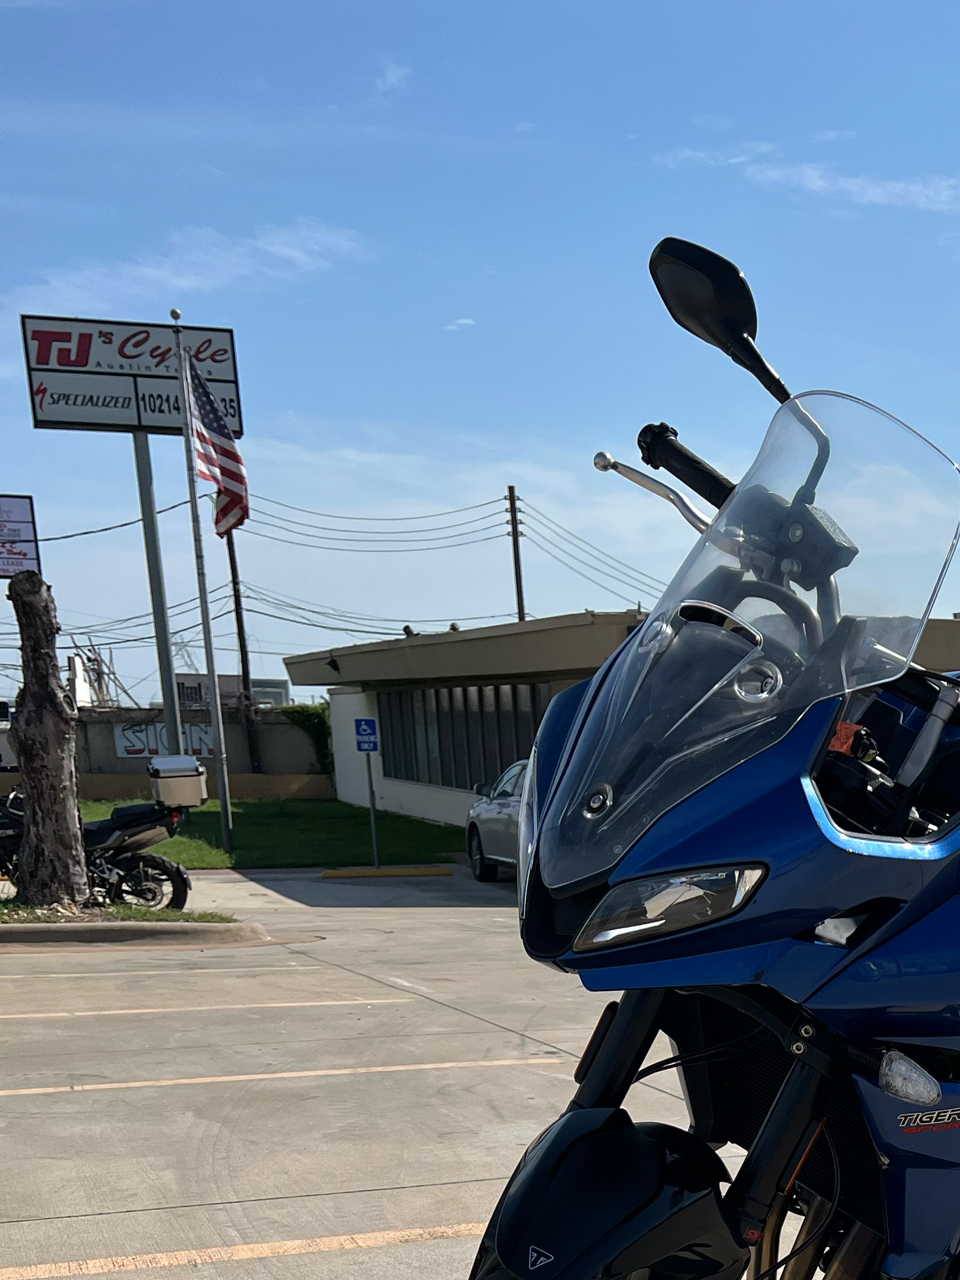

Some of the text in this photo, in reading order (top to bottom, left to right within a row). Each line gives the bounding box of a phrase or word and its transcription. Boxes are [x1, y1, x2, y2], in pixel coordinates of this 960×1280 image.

[117, 329, 231, 368] Cyle
[95, 361, 152, 372] Austin
[48, 392, 132, 410] SPECIALIZED
[140, 392, 181, 415] 10214
